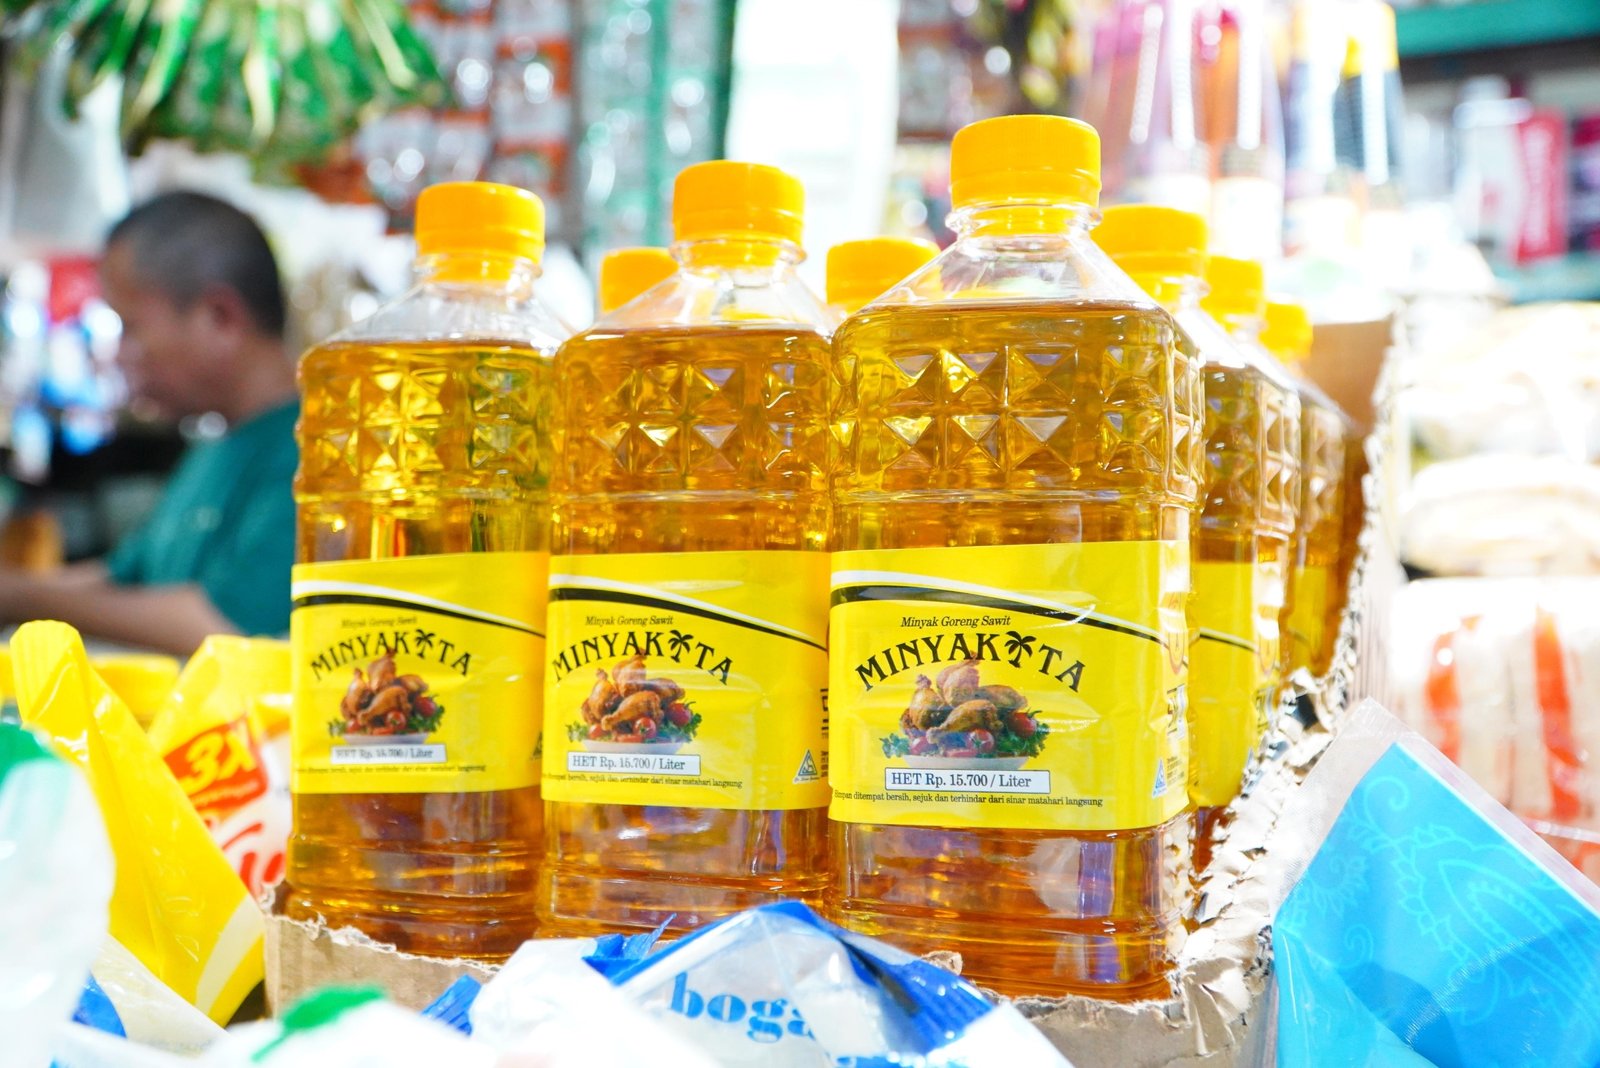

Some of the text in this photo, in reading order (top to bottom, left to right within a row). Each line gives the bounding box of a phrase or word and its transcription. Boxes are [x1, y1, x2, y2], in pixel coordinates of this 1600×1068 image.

[585, 615, 674, 627] Minyak Goreng Sawit
[901, 615, 1012, 629] Minyak Goreng Sawit
[572, 755, 597, 768] HET
[600, 756, 616, 771] Rp.
[620, 757, 650, 769] 15.700
[659, 758, 686, 770] Liter
[891, 772, 922, 785] HET
[926, 773, 946, 788] Rp.
[950, 774, 988, 786] 15.700
[999, 774, 1032, 787] Liter
[853, 791, 884, 802] ditempat
[886, 793, 911, 802] bersih,
[913, 793, 933, 804] sejuk
[934, 794, 949, 802] dan
[950, 794, 986, 803] terhindar
[988, 795, 1004, 803] dari
[1006, 795, 1026, 804] sinar
[1028, 796, 1064, 805] matahari
[1065, 797, 1103, 807] langsung
